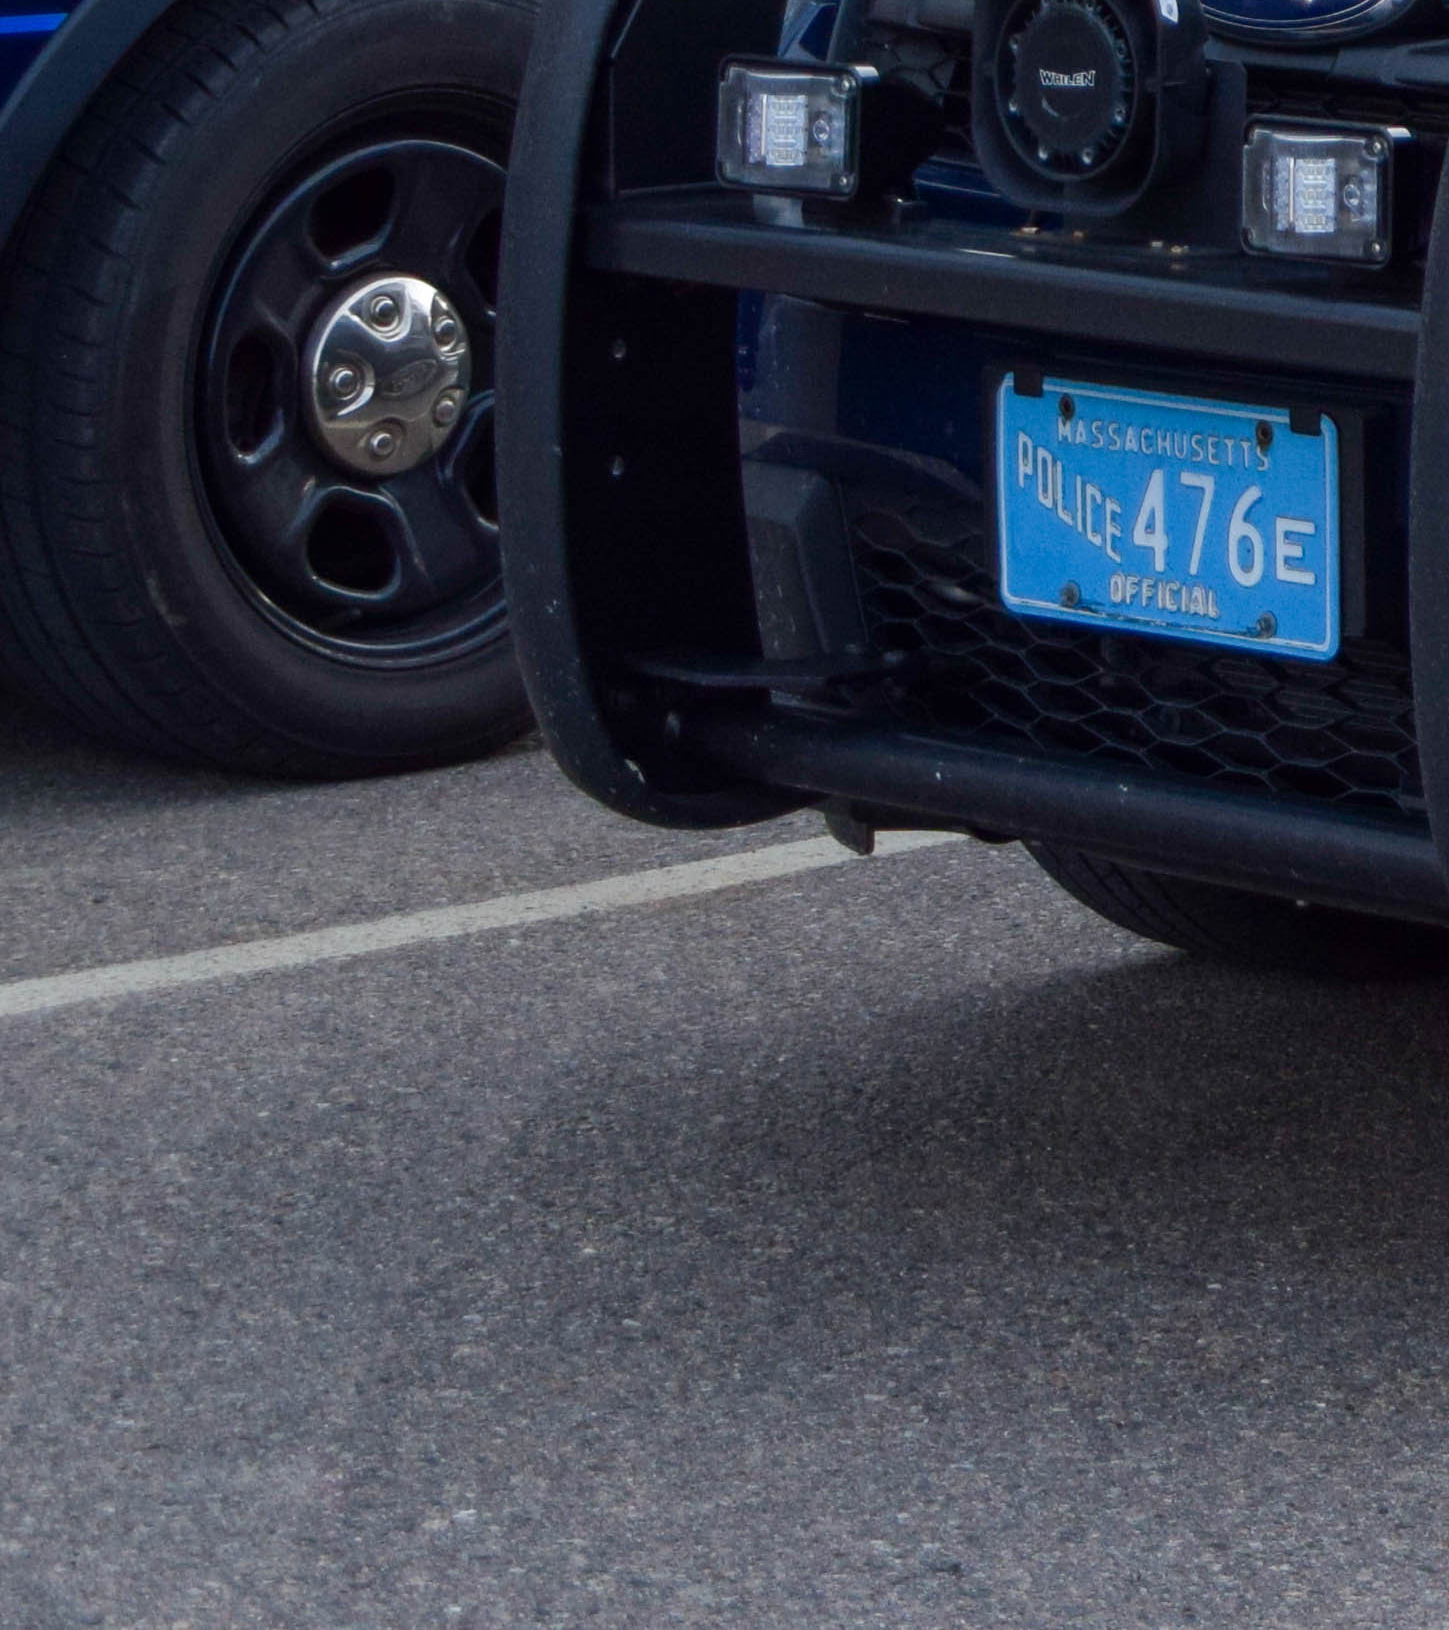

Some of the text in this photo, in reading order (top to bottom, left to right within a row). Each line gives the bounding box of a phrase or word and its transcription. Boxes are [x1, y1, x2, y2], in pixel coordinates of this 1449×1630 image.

[1058, 417, 1271, 471] MASSACHUSETTS
[1017, 430, 1122, 564] POLICE
[1109, 571, 1221, 620] OFFICIAL
